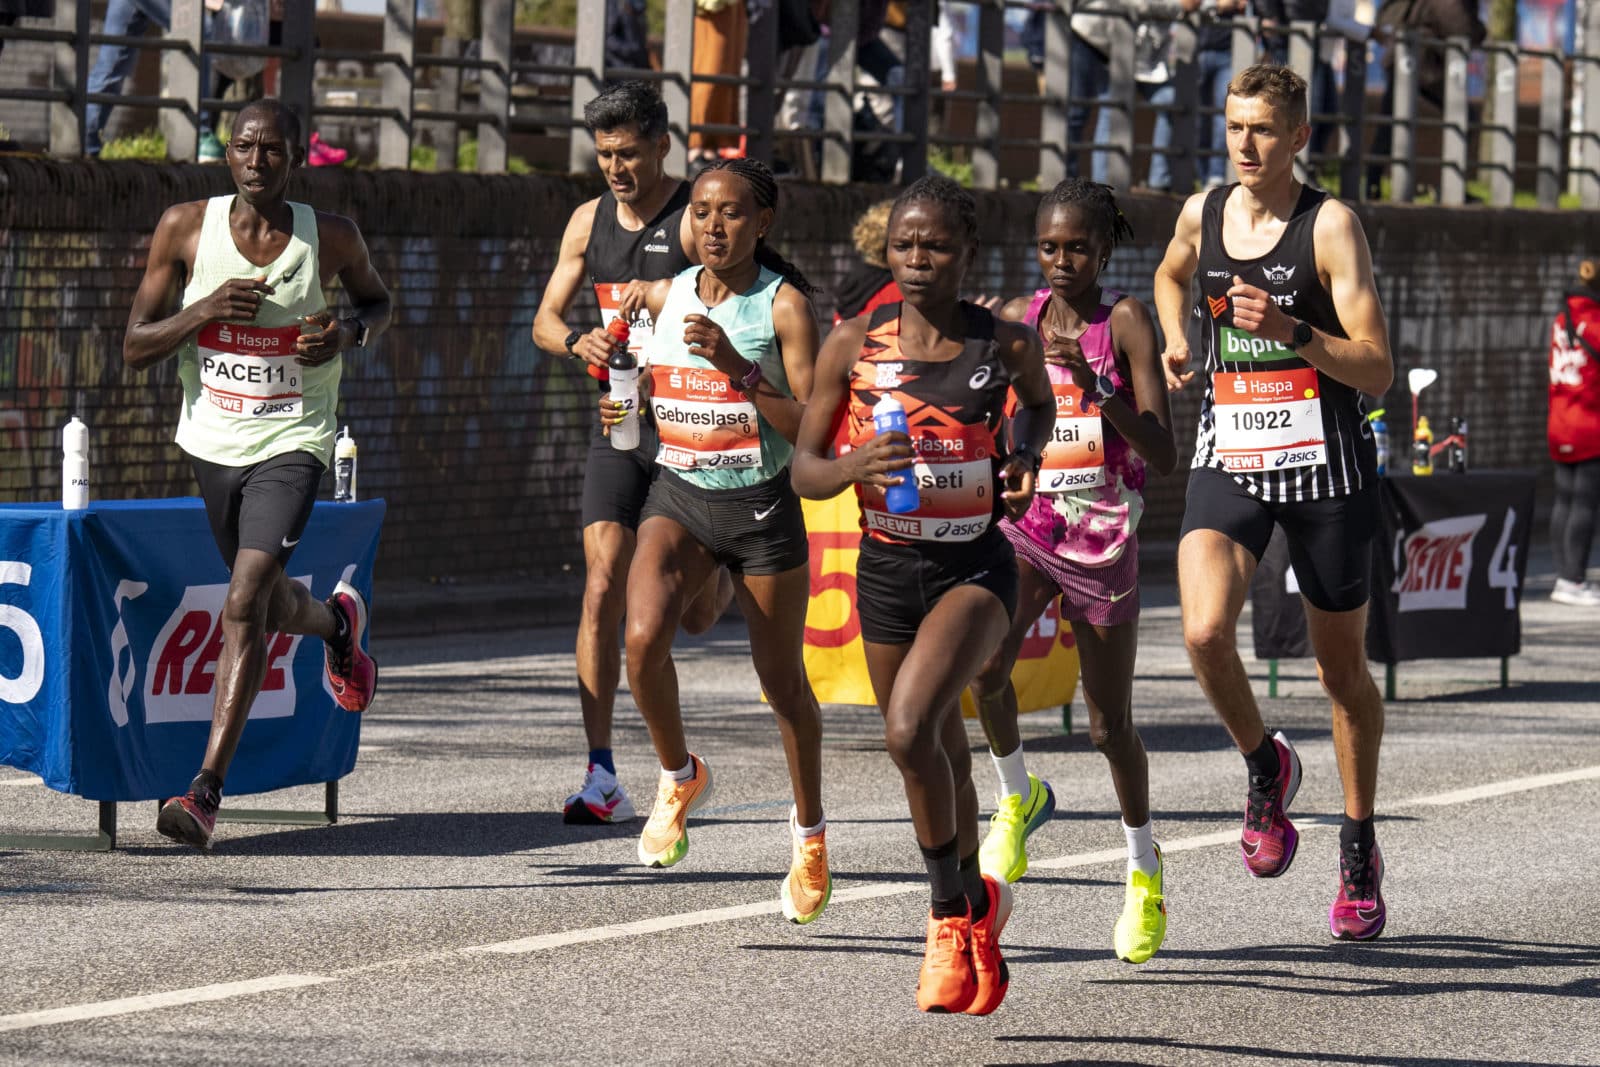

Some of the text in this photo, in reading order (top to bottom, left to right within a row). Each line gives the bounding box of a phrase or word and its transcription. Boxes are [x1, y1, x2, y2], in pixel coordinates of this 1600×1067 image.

[236, 332, 280, 350] Haspa
[203, 357, 285, 384] PACE11
[289, 377, 297, 387] 0
[685, 374, 728, 395] Haspa
[1249, 380, 1294, 396] Haspa
[266, 402, 294, 414] asics
[655, 404, 749, 426] Gebreslase
[742, 423, 751, 434] 0
[1231, 409, 1292, 431] 10922
[1050, 424, 1080, 442] tai
[1087, 440, 1096, 452] 0
[665, 449, 696, 467] REWE
[722, 454, 752, 465] asics
[1224, 455, 1263, 470] REWE
[1288, 450, 1318, 464] asics
[916, 469, 963, 489] seti
[1065, 472, 1097, 485] asics
[976, 485, 985, 498] 0
[875, 514, 920, 536] REWE
[951, 521, 984, 536] asics
[1487, 507, 1519, 610] 4
[803, 531, 862, 648] 5
[151, 609, 295, 696] REE
